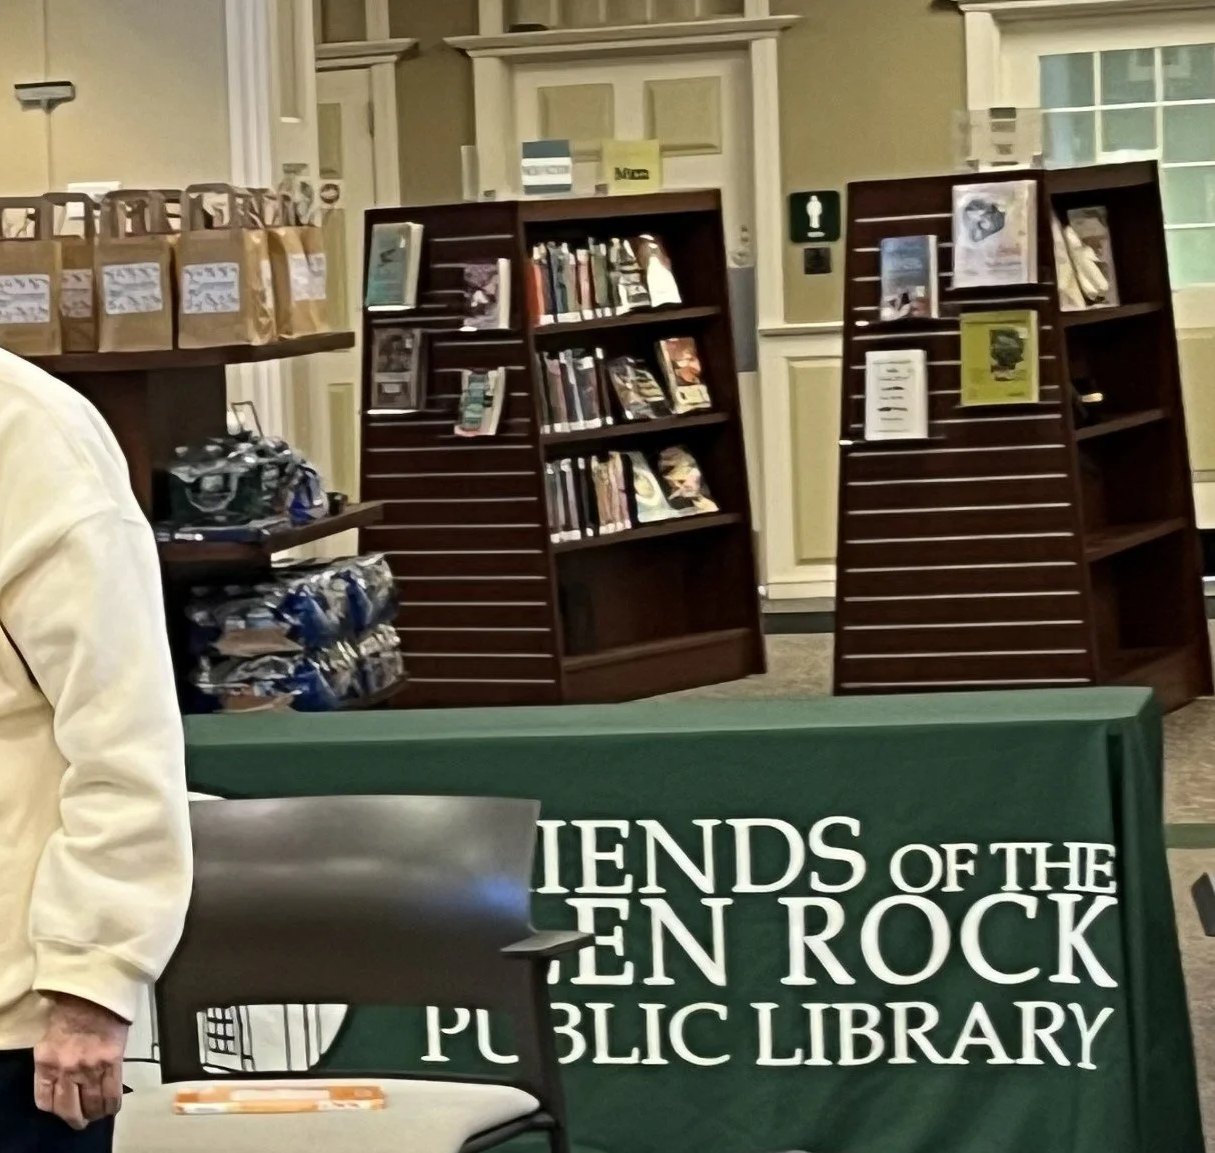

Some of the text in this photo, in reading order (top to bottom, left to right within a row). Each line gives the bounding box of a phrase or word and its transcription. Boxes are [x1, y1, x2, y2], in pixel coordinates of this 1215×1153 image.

[528, 815, 1117, 894] IENDS OF THE
[547, 892, 1119, 988] EN ROCK
[752, 1001, 1115, 1070] LIBRARY
